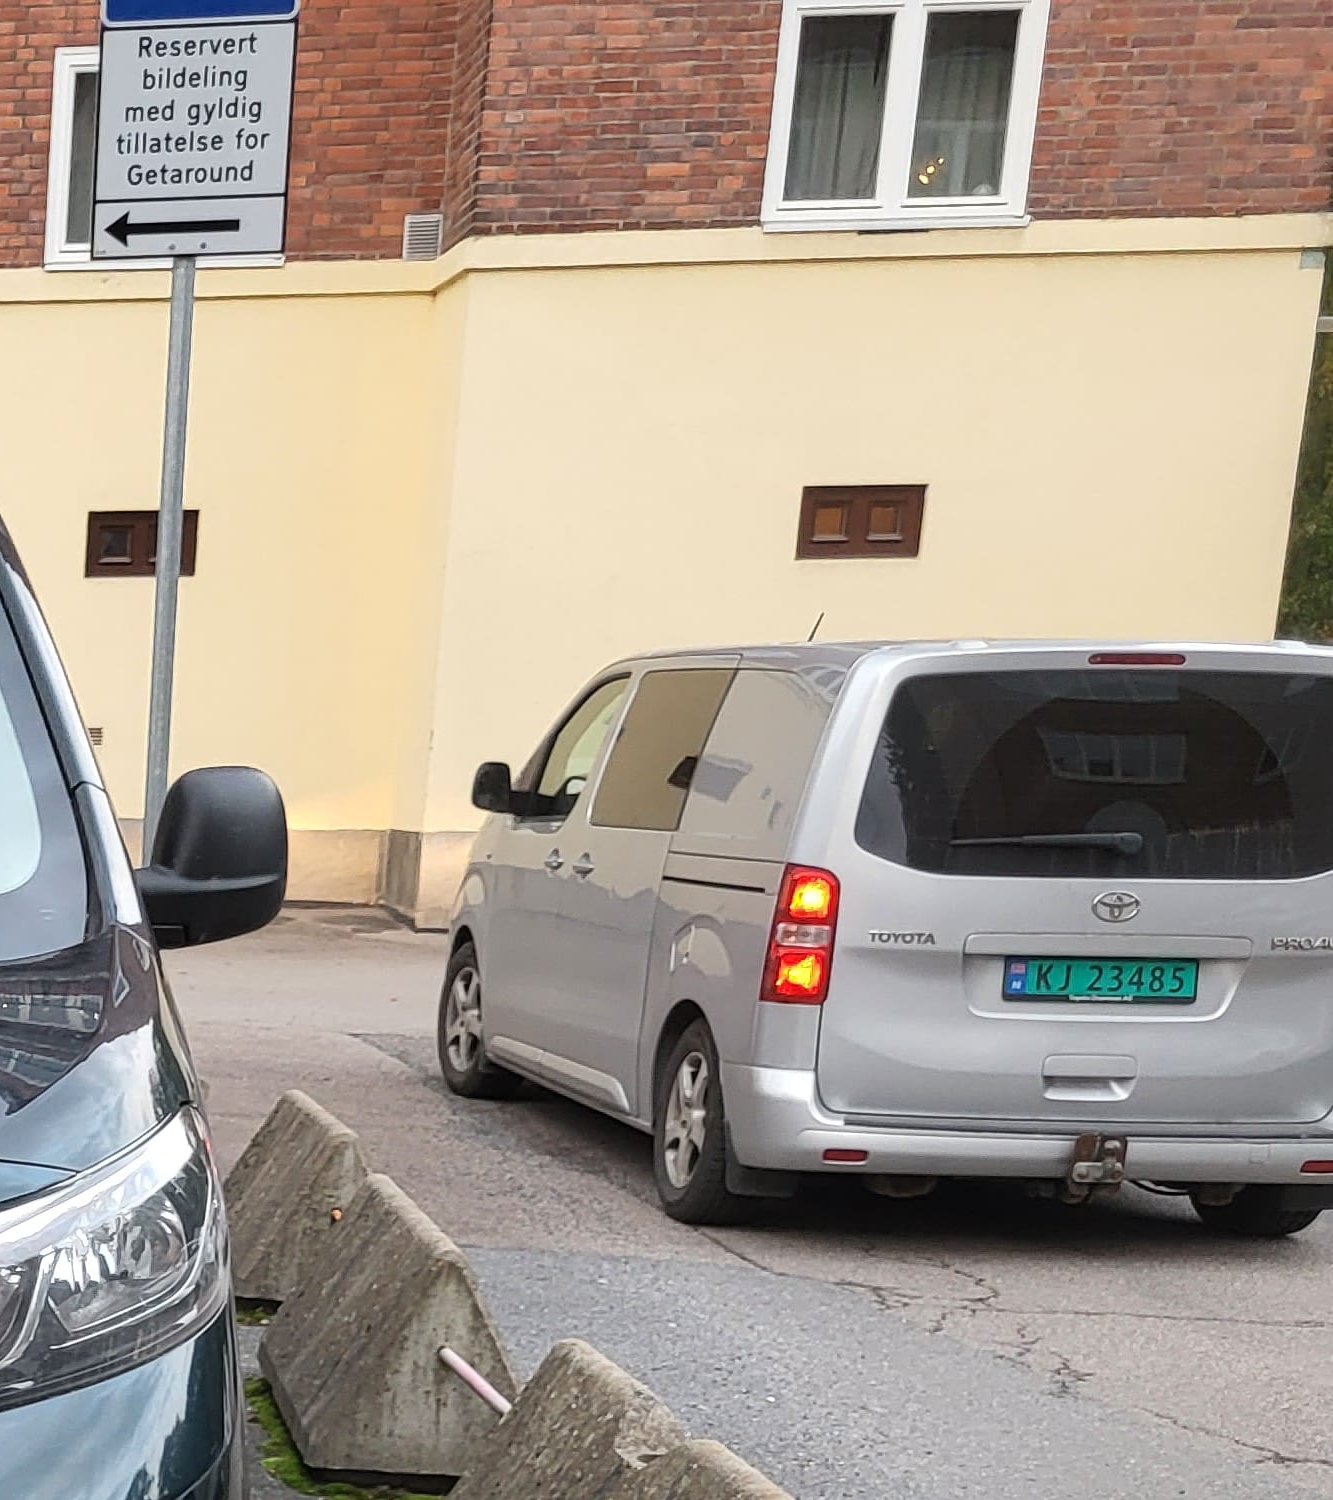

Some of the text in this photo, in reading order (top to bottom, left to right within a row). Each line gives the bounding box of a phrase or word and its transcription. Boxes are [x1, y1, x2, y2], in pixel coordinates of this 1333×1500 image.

[137, 32, 258, 58] Reservert
[142, 65, 248, 92] bildeling
[125, 96, 262, 126] med gyldig
[116, 128, 270, 155] tillatelse for
[127, 160, 254, 186] Getaround
[868, 930, 936, 945] TOYOTA
[1270, 936, 1333, 951] PROA
[1036, 963, 1186, 993] KJ 23485
